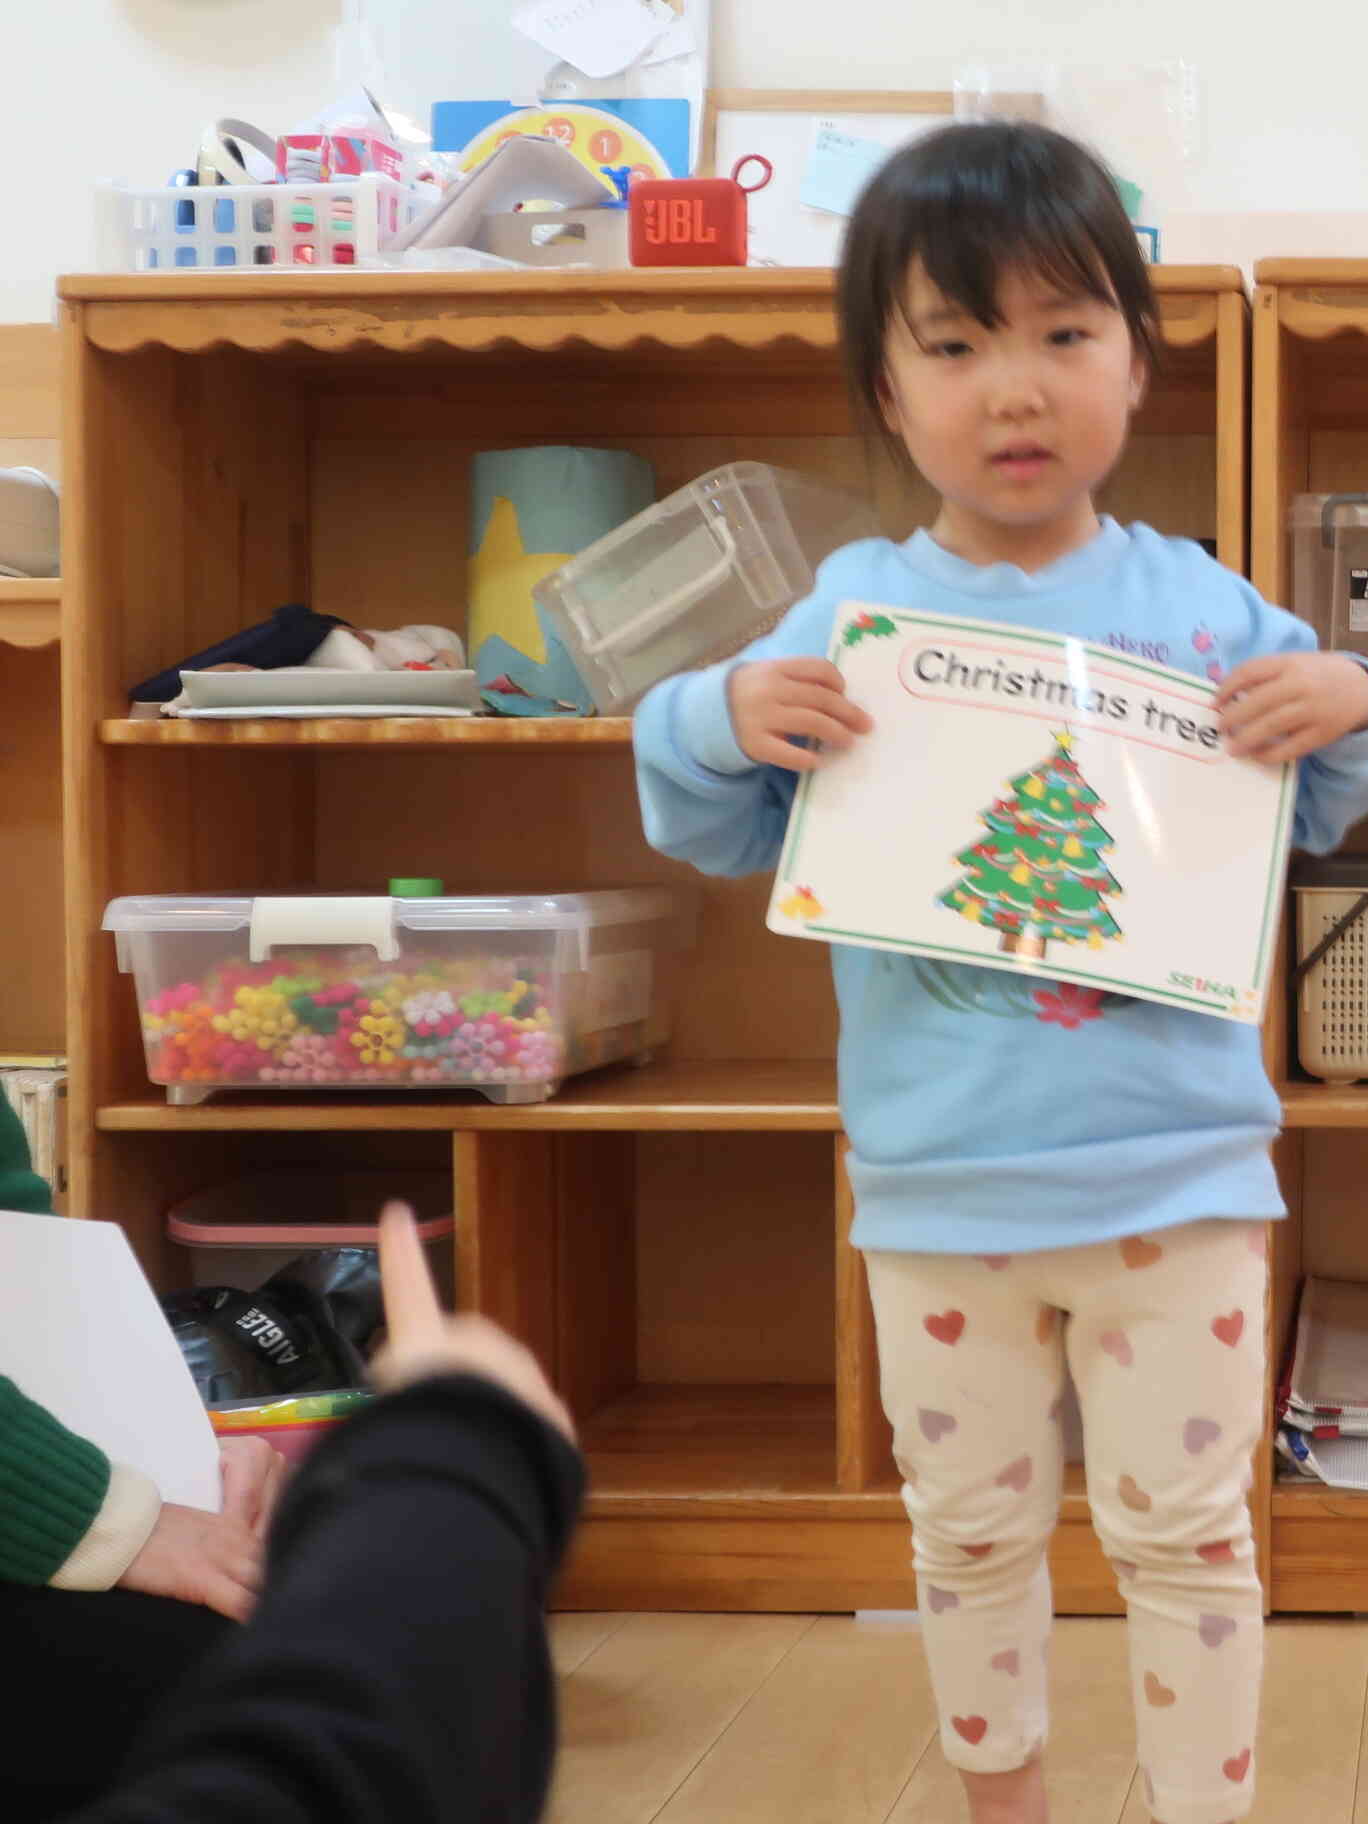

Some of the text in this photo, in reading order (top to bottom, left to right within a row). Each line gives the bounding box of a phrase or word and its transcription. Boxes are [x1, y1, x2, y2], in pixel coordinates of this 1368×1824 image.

[644, 199, 718, 244] JBL
[912, 647, 1220, 750] Christmas tree
[235, 1306, 300, 1366] AIGLE
